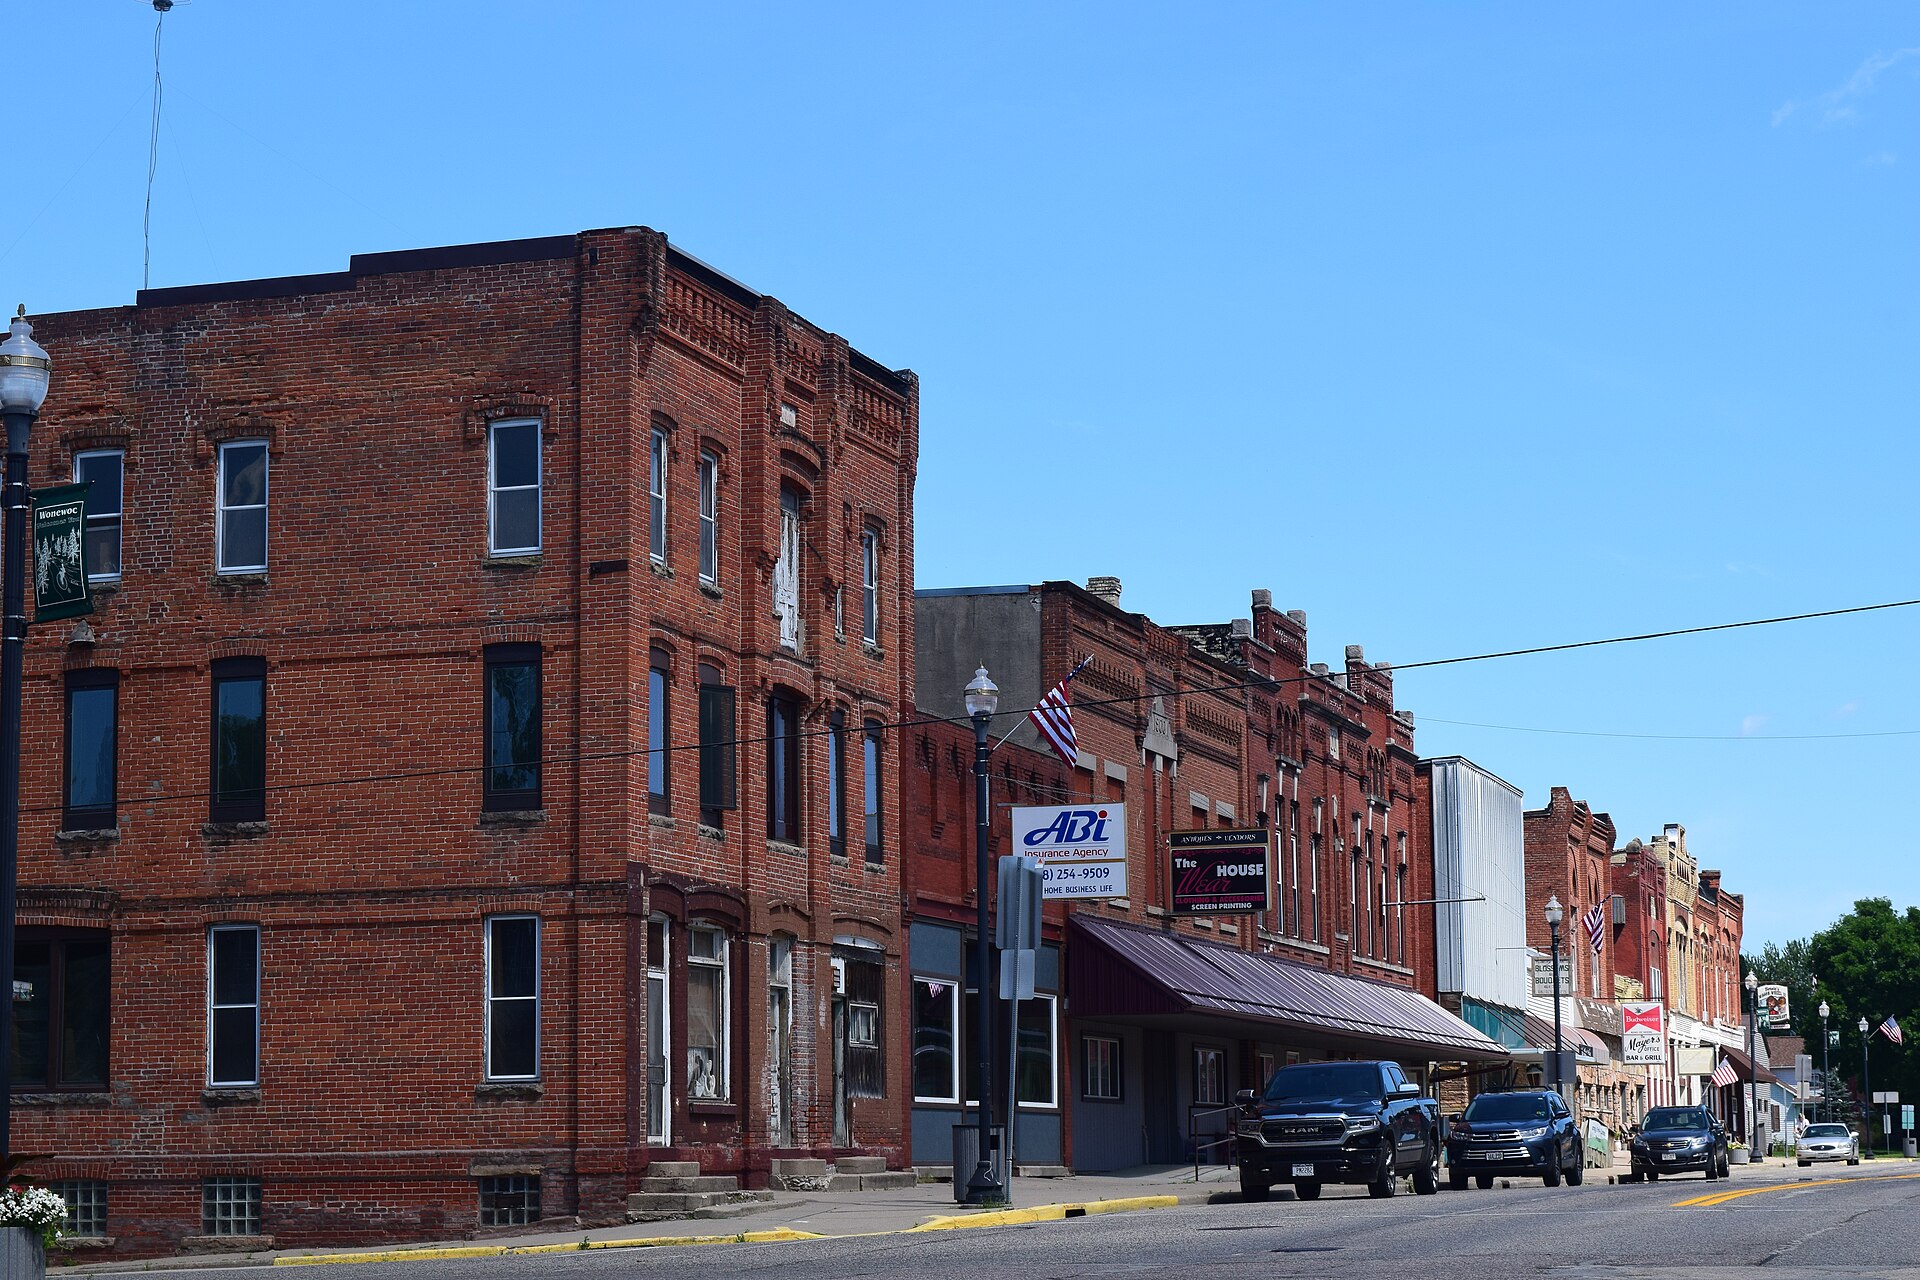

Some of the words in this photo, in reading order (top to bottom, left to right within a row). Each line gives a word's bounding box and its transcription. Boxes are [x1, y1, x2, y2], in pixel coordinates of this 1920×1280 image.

[40, 507, 78, 519] Wonewoc
[1224, 833, 1256, 842] VENDORS
[1024, 850, 1070, 858] Insurance
[1072, 848, 1109, 858] Agency
[1174, 858, 1198, 868] The
[1216, 863, 1264, 877] HOUSE
[1176, 861, 1231, 894] Wear
[1044, 886, 1063, 894] HOME
[1065, 885, 1097, 893] BUSINESS
[1099, 884, 1113, 892] LIFE
[1219, 895, 1265, 903] ACCESSORIES
[1535, 964, 1570, 972] BLOSSMS
[1535, 976, 1570, 984] BOUQTS
[1625, 1015, 1659, 1023] Budweiser
